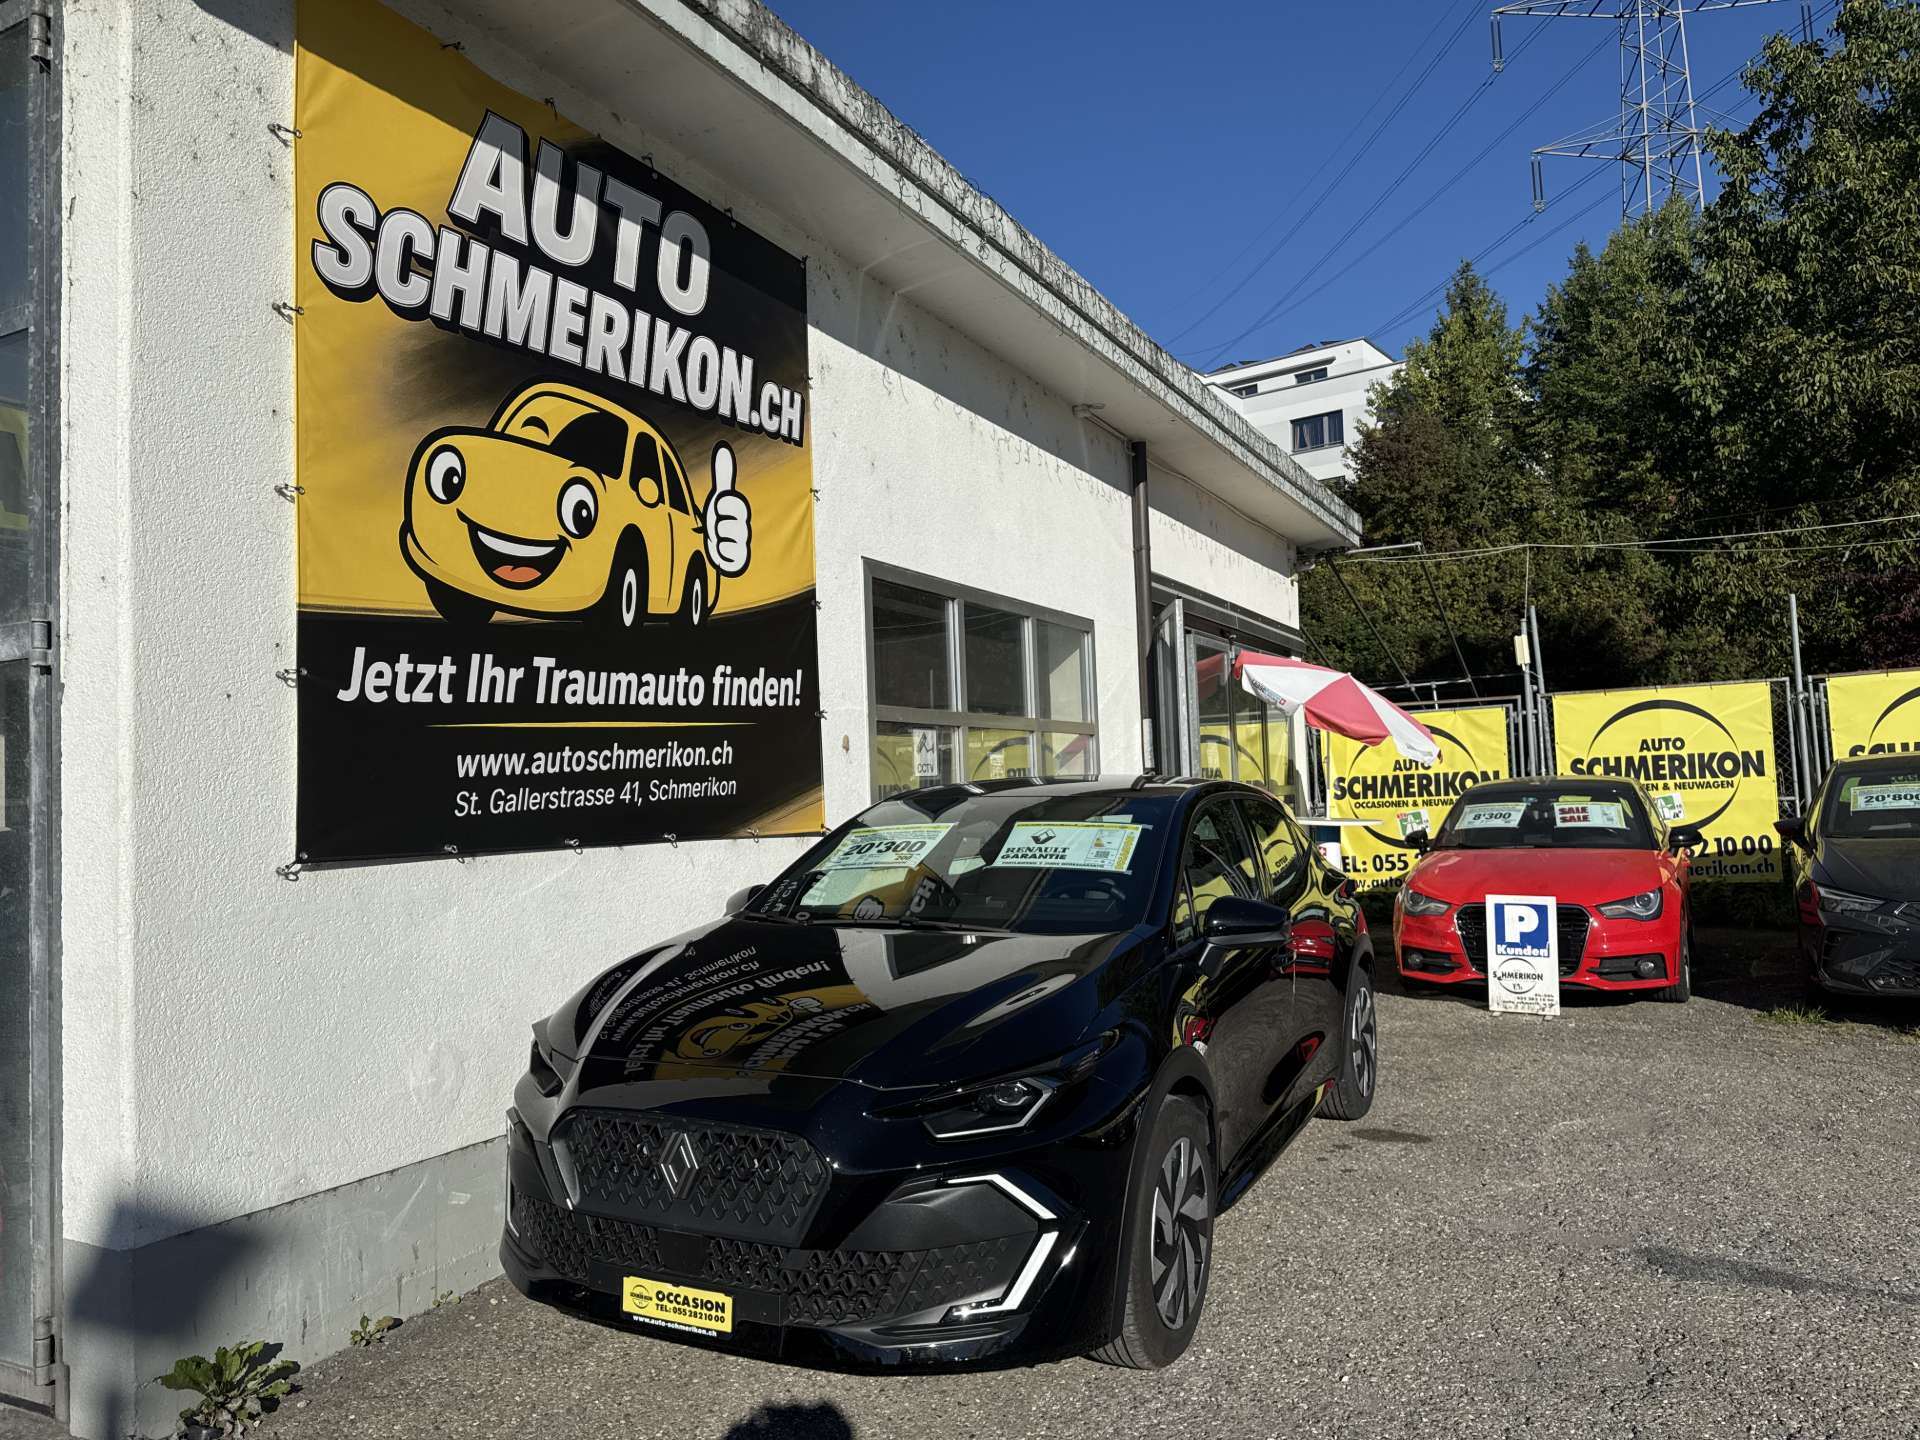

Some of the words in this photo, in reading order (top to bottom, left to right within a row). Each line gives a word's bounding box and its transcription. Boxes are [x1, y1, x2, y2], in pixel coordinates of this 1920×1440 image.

[447, 111, 712, 317] AUTO
[313, 183, 803, 443] SCHMERIKON.CH
[337, 646, 457, 704] Jetzt
[466, 654, 524, 705] Ihr
[533, 656, 705, 707] Traumauto
[712, 665, 803, 708] finden!
[1639, 737, 1686, 753] AUTO
[456, 740, 733, 778] www.autoschmerikon.ch
[917, 764, 934, 773] CCTV
[1570, 750, 1766, 781] SCHMERIKON
[1662, 783, 1670, 791] &
[1675, 780, 1735, 791] NEUWAGEN
[454, 790, 482, 817] St.
[490, 785, 615, 814] Gallerstrasse
[620, 781, 643, 807] 41,
[649, 777, 737, 801] Schmerikon
[1354, 800, 1410, 809] OCCASIONEN
[1412, 799, 1419, 807] &
[1422, 798, 1456, 807] NEUWA
[1473, 812, 1512, 821] 8'300
[1558, 806, 1589, 814] SALE
[1559, 814, 1591, 823] SALE
[842, 840, 927, 856] 20'300
[1341, 855, 1368, 873] EL:
[1372, 853, 1409, 873] 055
[1504, 904, 1539, 943] P
[655, 1290, 726, 1314] OCCASION
[655, 1303, 672, 1313] TEL:
[633, 1315, 717, 1337] www.auto-schmerikon.ch
